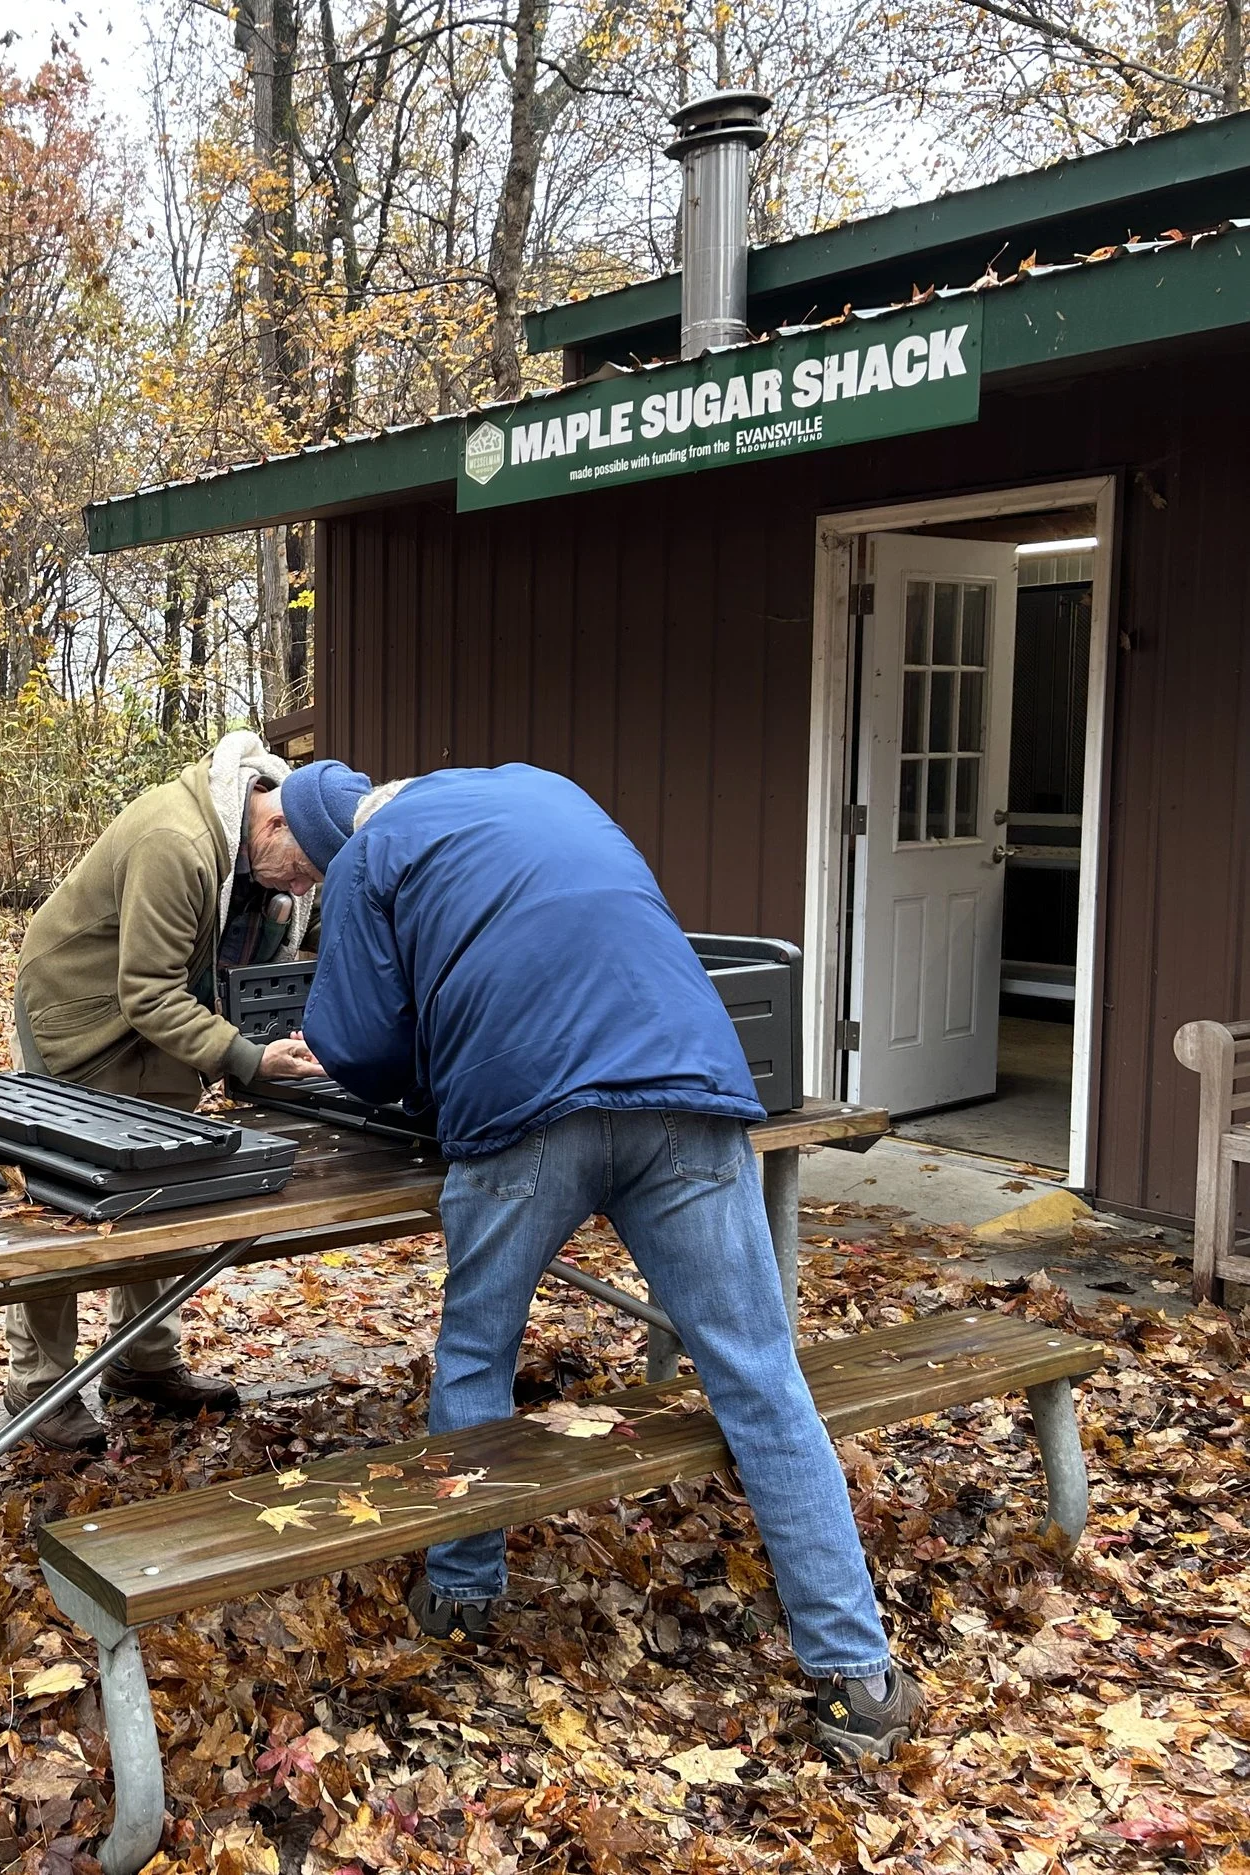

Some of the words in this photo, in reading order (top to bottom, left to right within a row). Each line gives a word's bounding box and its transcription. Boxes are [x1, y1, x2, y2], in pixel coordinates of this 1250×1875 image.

[510, 400, 633, 465] MAPLE
[640, 368, 783, 439] SUGAR
[792, 324, 970, 409] SHACK
[736, 416, 823, 446] EVANSVILLE
[736, 438, 793, 455] ENDOWMENT
[798, 432, 823, 444] FUND
[570, 465, 592, 480] made
[594, 459, 629, 479] possible
[630, 455, 650, 469] with
[651, 449, 687, 465] funding
[689, 444, 711, 457] from
[713, 440, 730, 453] the
